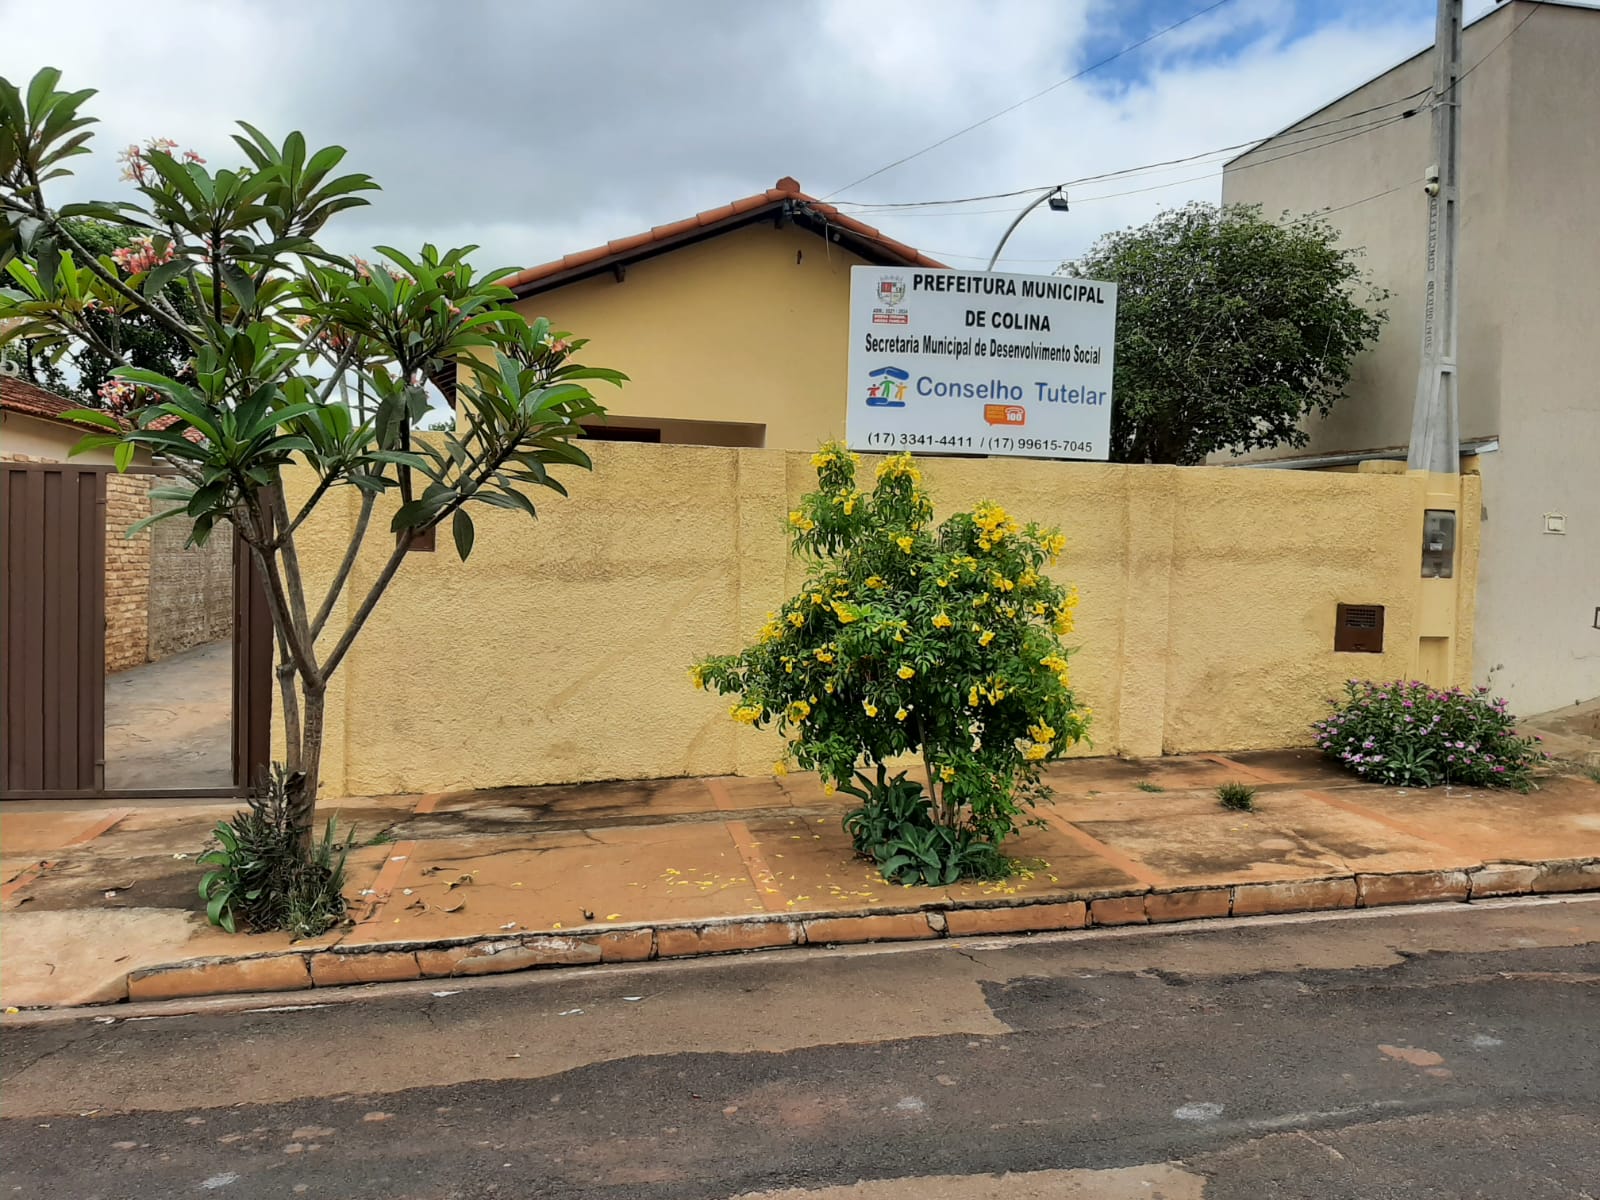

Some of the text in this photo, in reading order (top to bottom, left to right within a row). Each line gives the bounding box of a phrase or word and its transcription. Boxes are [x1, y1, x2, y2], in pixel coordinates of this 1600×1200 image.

[913, 274, 1105, 304] PREFEITURA MUNICIPAL
[965, 310, 1050, 332] DE COLINA
[866, 333, 1100, 364] Secretaria Municipal de Desenvolvimento Social
[917, 376, 1106, 405] Conselho Tutelar
[1007, 413, 1022, 421] 100
[868, 432, 895, 446] (17)
[900, 434, 971, 447] 3341-4411
[989, 438, 1014, 451] (17)
[1018, 439, 1092, 452] 99615-7045
